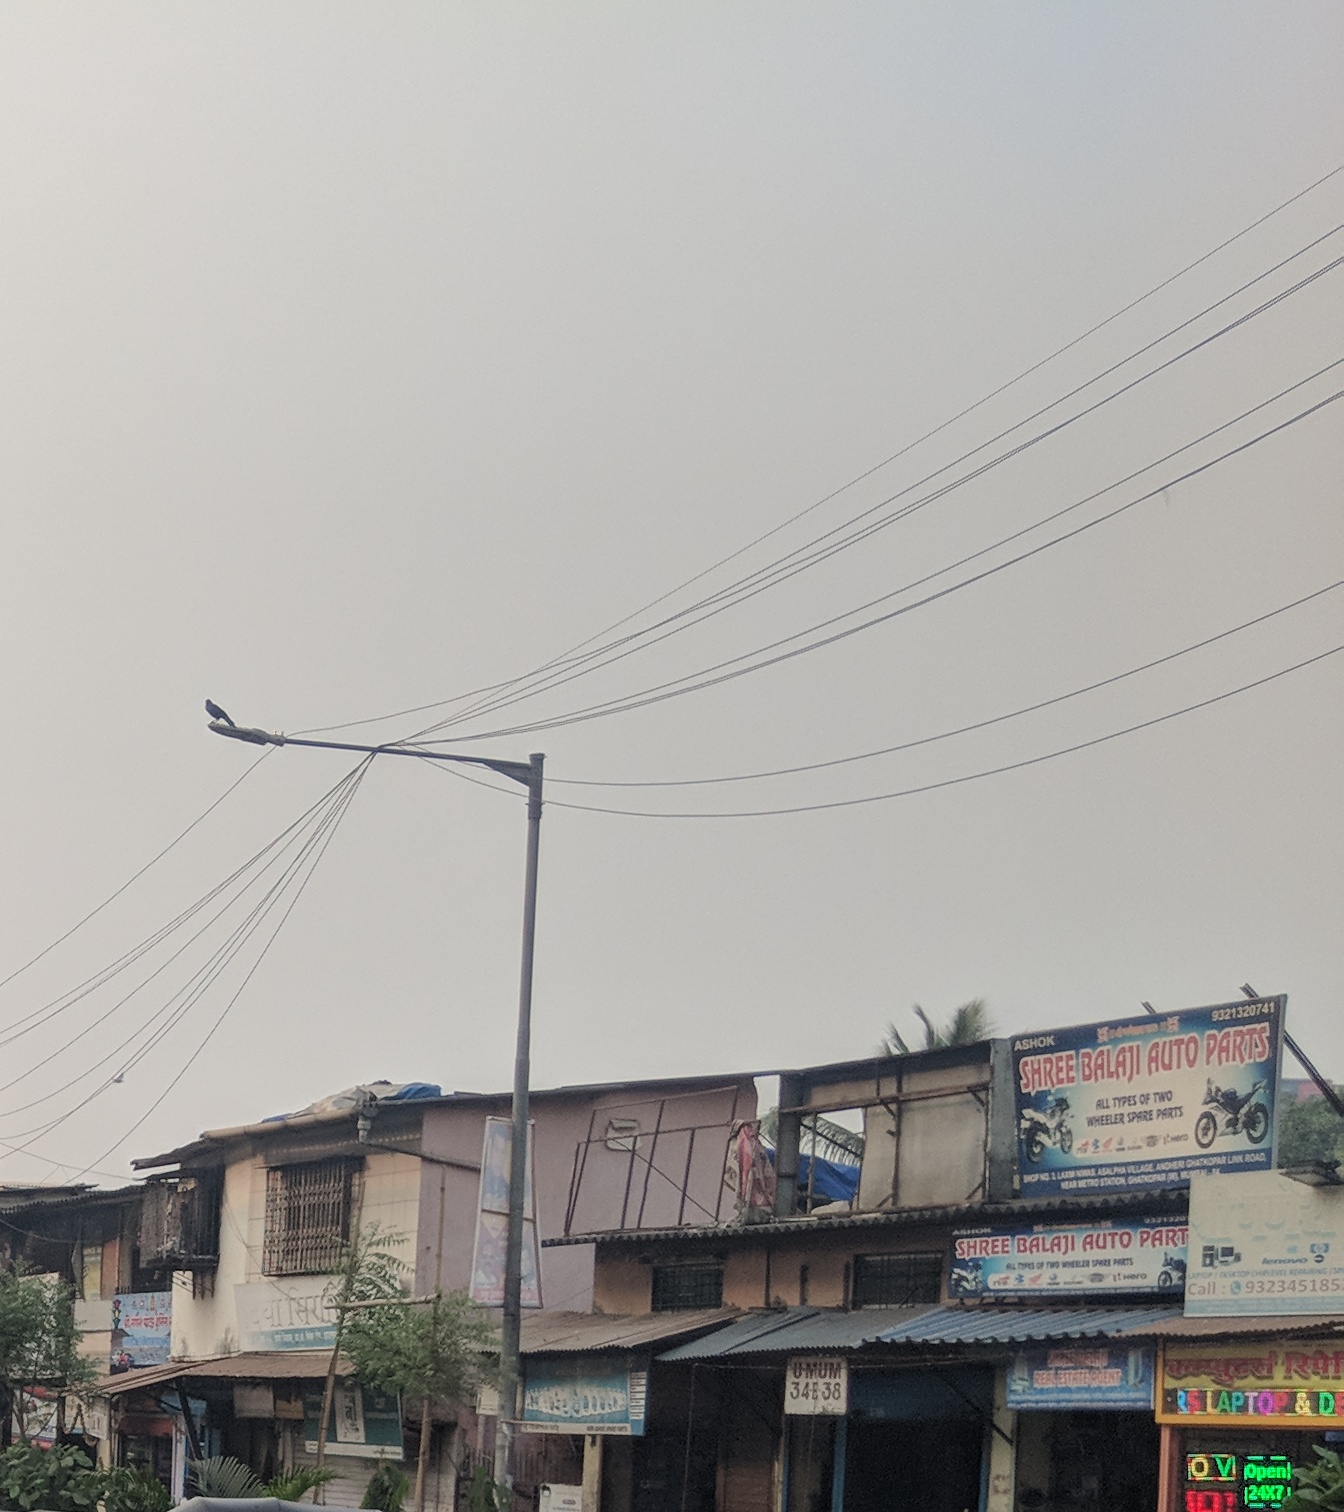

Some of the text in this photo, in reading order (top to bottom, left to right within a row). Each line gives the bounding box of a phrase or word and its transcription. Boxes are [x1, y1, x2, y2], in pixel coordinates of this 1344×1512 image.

[1211, 1001, 1275, 1021] 9321320741
[1013, 1035, 1055, 1051] ASHOK
[1019, 1051, 1076, 1092] SHREE
[1080, 1042, 1141, 1083] BALAJI
[1146, 1033, 1199, 1076] AUTO
[1204, 1023, 1271, 1068] PARTS
[1095, 1090, 1173, 1110] ALL TYPES OF TWO
[1086, 1106, 1183, 1128] WHEELER SPARE PARTS
[956, 1237, 1010, 1259] SHREE
[1016, 1232, 1076, 1255] BALAJI
[1082, 1229, 1133, 1250] AUTO
[1018, 1261, 1035, 1270] TYPES
[1046, 1260, 1060, 1268] TWO
[1062, 1260, 1090, 1268] WHEELER
[1091, 1259, 1112, 1268] SPARE
[1113, 1258, 1134, 1266] PARTS
[1187, 1282, 1216, 1296] Call
[1245, 1278, 1344, 1294] 932345185
[1206, 1390, 1289, 1415] LAPTOP
[1295, 1392, 1311, 1414] &
[1244, 1463, 1287, 1482] Open
